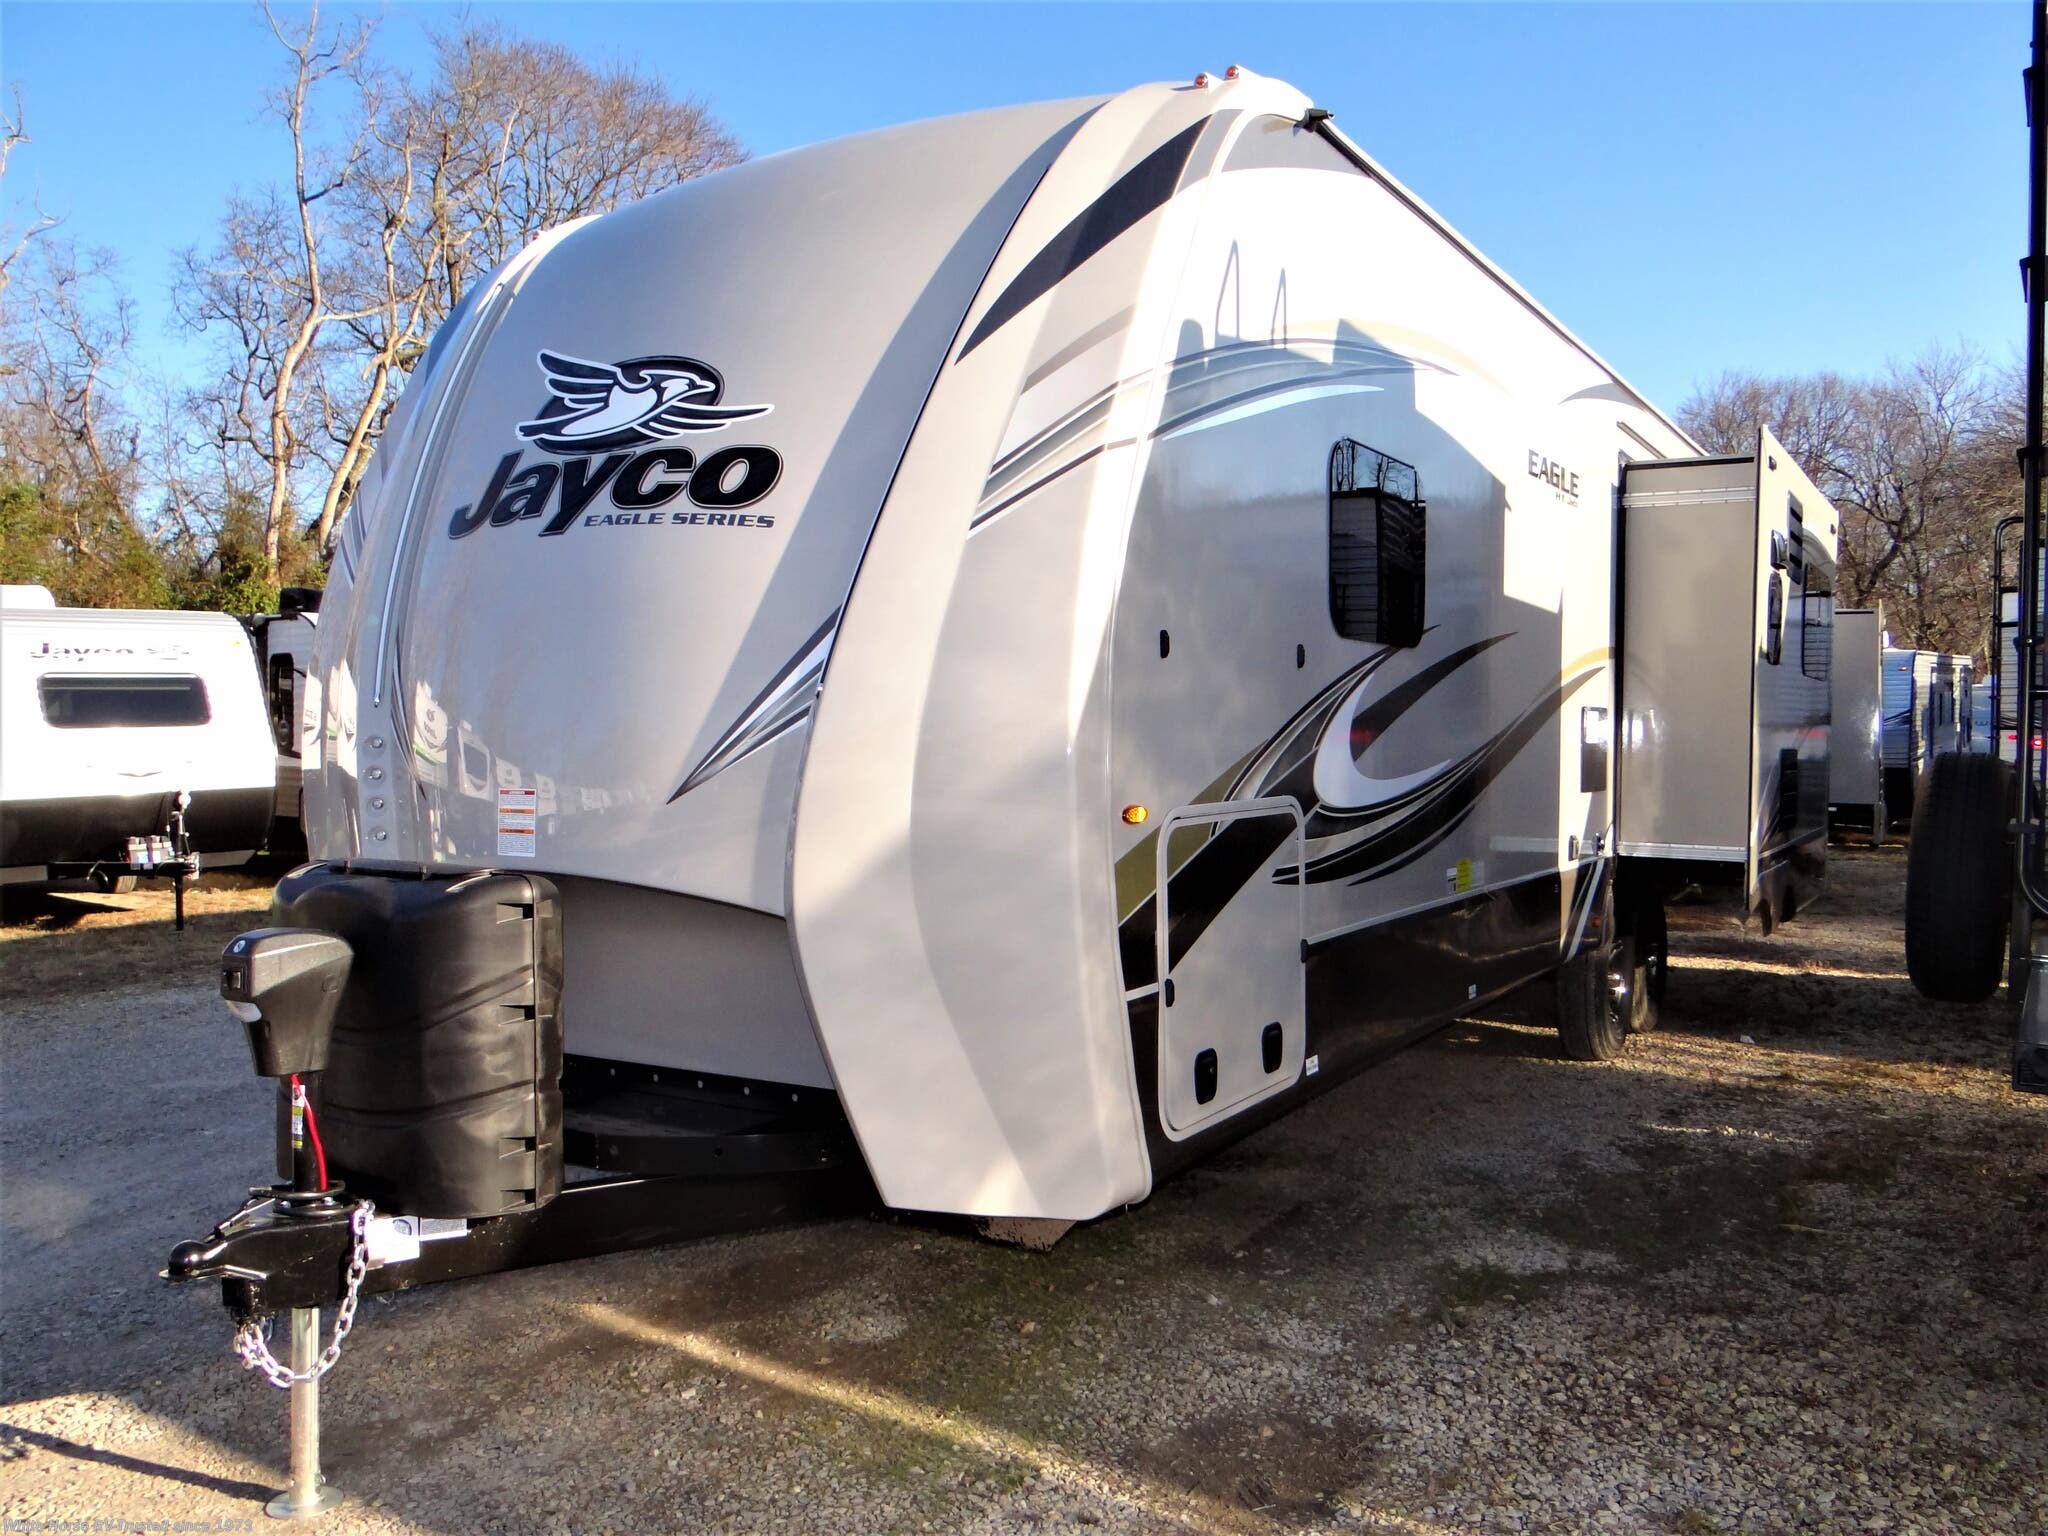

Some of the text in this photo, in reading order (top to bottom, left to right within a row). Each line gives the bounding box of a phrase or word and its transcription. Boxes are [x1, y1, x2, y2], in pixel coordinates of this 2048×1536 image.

[448, 444, 784, 540] Jayco
[1528, 448, 1579, 498] EAGLE
[584, 512, 776, 529] EAGLE SERIES
